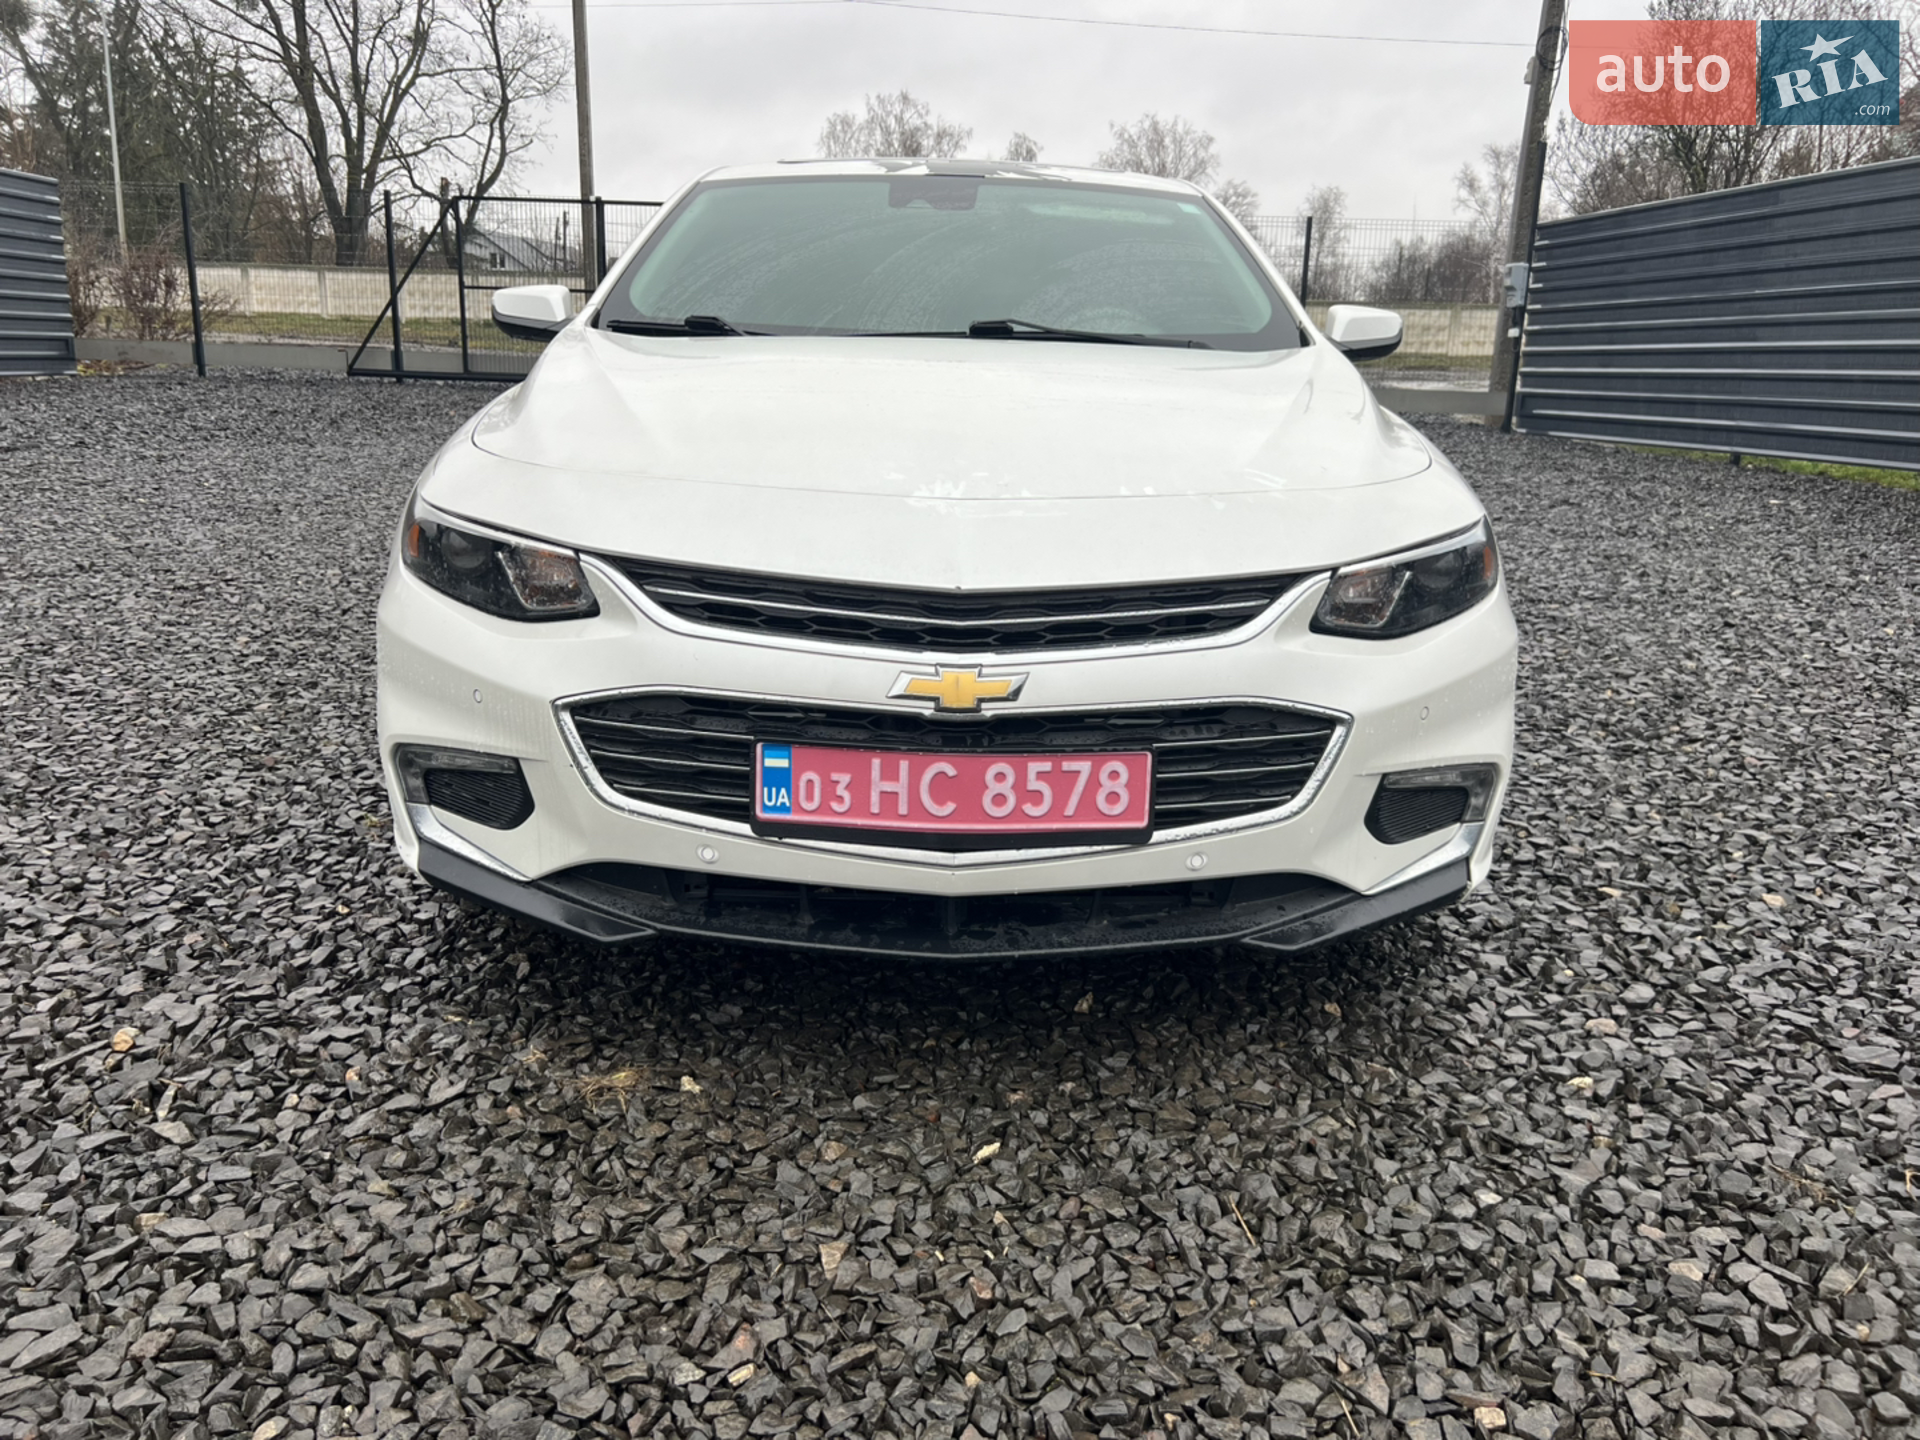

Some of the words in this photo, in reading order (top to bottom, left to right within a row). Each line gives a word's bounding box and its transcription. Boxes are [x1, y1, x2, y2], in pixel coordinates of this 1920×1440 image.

[763, 786, 791, 808] UA
[798, 770, 852, 814] 03
[870, 757, 958, 818] HC
[982, 760, 1131, 819] 8578
